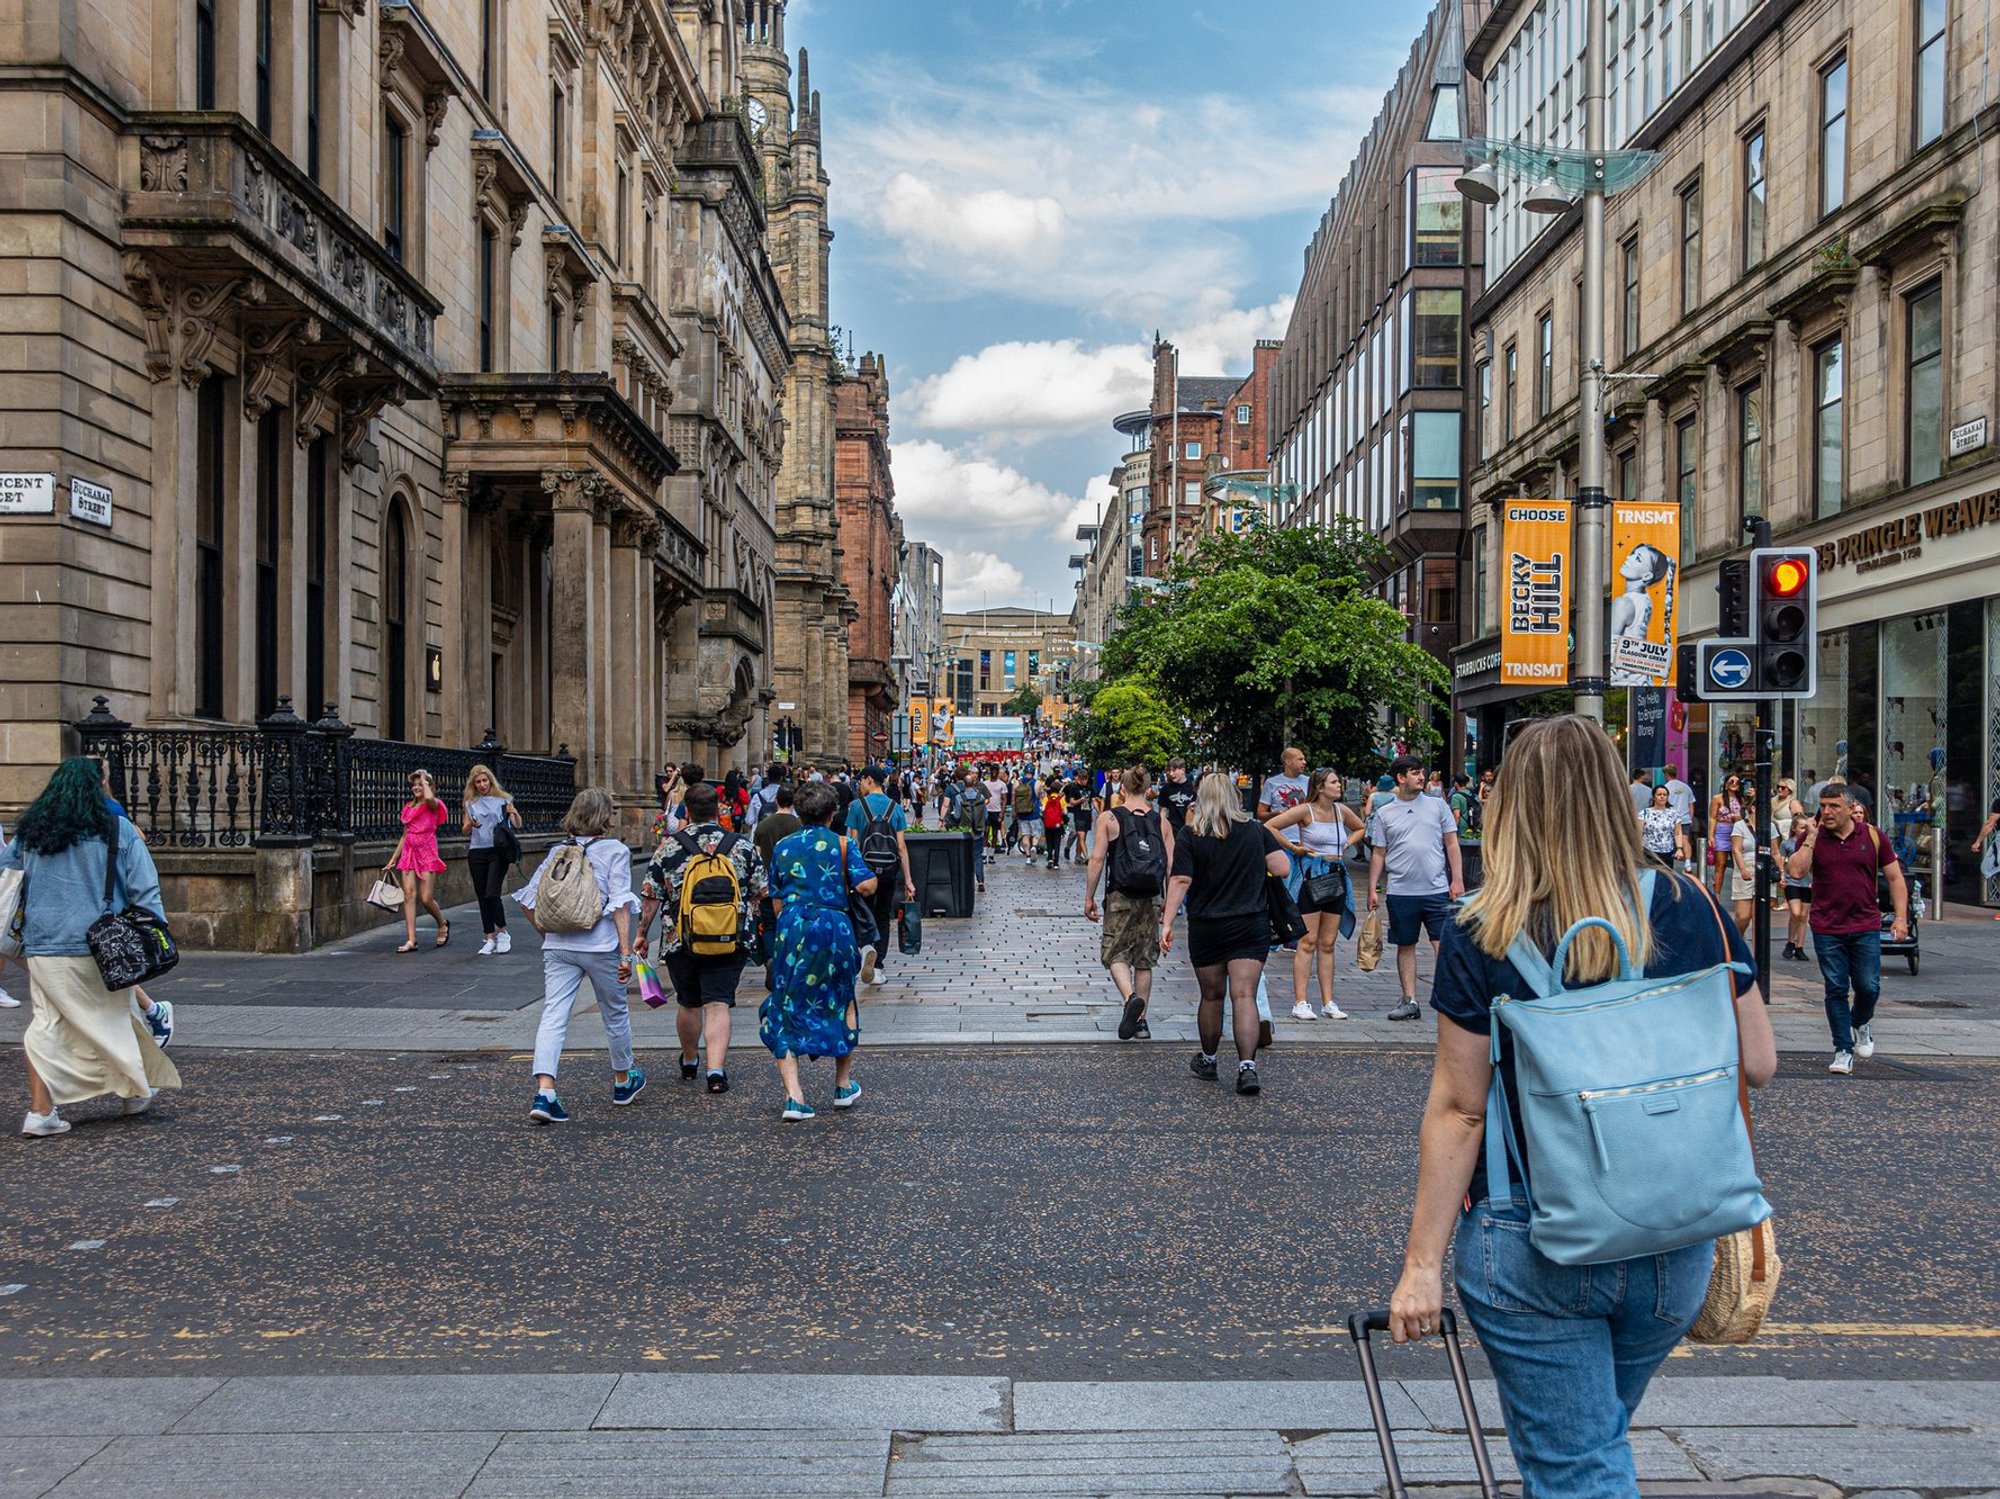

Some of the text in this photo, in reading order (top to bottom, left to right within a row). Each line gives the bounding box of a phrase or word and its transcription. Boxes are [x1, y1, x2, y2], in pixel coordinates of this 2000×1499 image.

[1952, 422, 1984, 440] BUCHANAN
[1956, 433, 1978, 448] STREET
[0, 478, 44, 489] CENT
[73, 480, 110, 503] BUCHANAN
[78, 496, 106, 516] STREET
[1508, 508, 1567, 522] CHOOSE
[1616, 509, 1676, 525] TRNSMT
[1837, 513, 1922, 567] PRINGLE
[1510, 552, 1532, 634] BECKY
[1529, 552, 1562, 634] HILL
[1620, 649, 1648, 659] GLASGOW
[1622, 639, 1669, 656] 9TH JULY
[1456, 656, 1486, 679] STARBUCKS
[1505, 662, 1565, 677] TRNSMT
[914, 707, 922, 732] PULP
